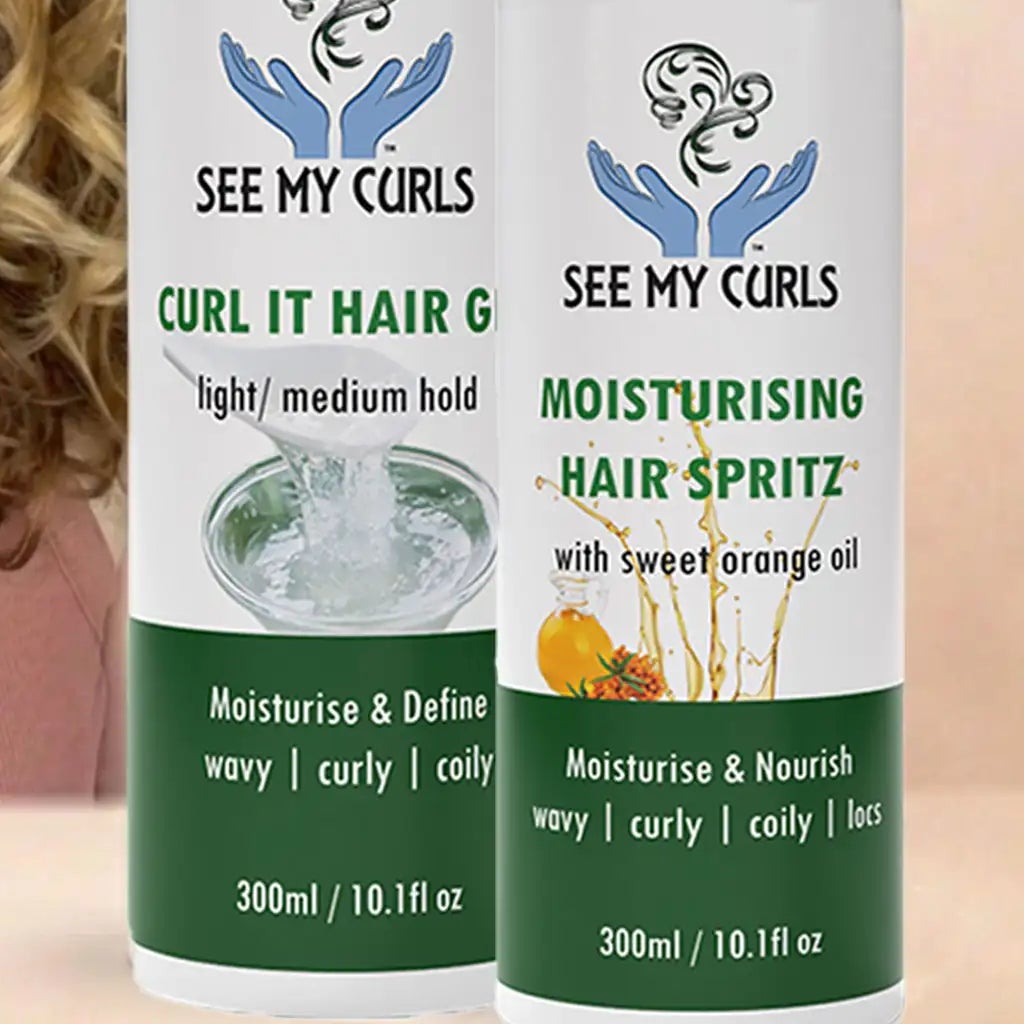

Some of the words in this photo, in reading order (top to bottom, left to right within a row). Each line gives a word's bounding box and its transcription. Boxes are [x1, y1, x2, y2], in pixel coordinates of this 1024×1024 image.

[196, 166, 263, 213] SEE
[277, 166, 340, 213] MY
[353, 166, 474, 214] CURLS
[563, 264, 631, 308] SEE
[645, 264, 709, 308] MY
[721, 264, 838, 308] CURLS
[158, 286, 250, 333] CURL
[269, 289, 312, 334] IT
[333, 289, 449, 334] HAIR
[466, 287, 497, 333] G
[198, 375, 271, 422] light/
[283, 378, 407, 413] medium
[420, 375, 477, 412] hold
[541, 376, 863, 421] MOISTURISING
[561, 456, 669, 499] HAIR
[688, 455, 845, 500] SPRITZ
[554, 540, 608, 573] with
[621, 546, 710, 575] sweet
[721, 547, 821, 581] orange
[831, 537, 859, 571] oil
[209, 686, 359, 725] Moisturise
[371, 692, 392, 725] &
[404, 687, 488, 723] Define
[204, 754, 272, 792] wavy
[318, 751, 392, 794] curly
[437, 744, 494, 787] coily
[566, 747, 713, 783] Moisturise
[724, 754, 745, 783] &
[756, 744, 853, 782] Nourish
[533, 805, 589, 843] wavy
[630, 807, 703, 848] curly
[749, 803, 813, 844] coily
[848, 799, 882, 829] locs
[236, 880, 318, 915] 300ml
[326, 883, 341, 924] /
[352, 881, 427, 915] 10.1fl
[436, 886, 463, 912] oz
[599, 926, 680, 959] 300ml
[689, 930, 703, 967] /
[714, 926, 788, 959] 10.1fl
[796, 931, 823, 955] oz
